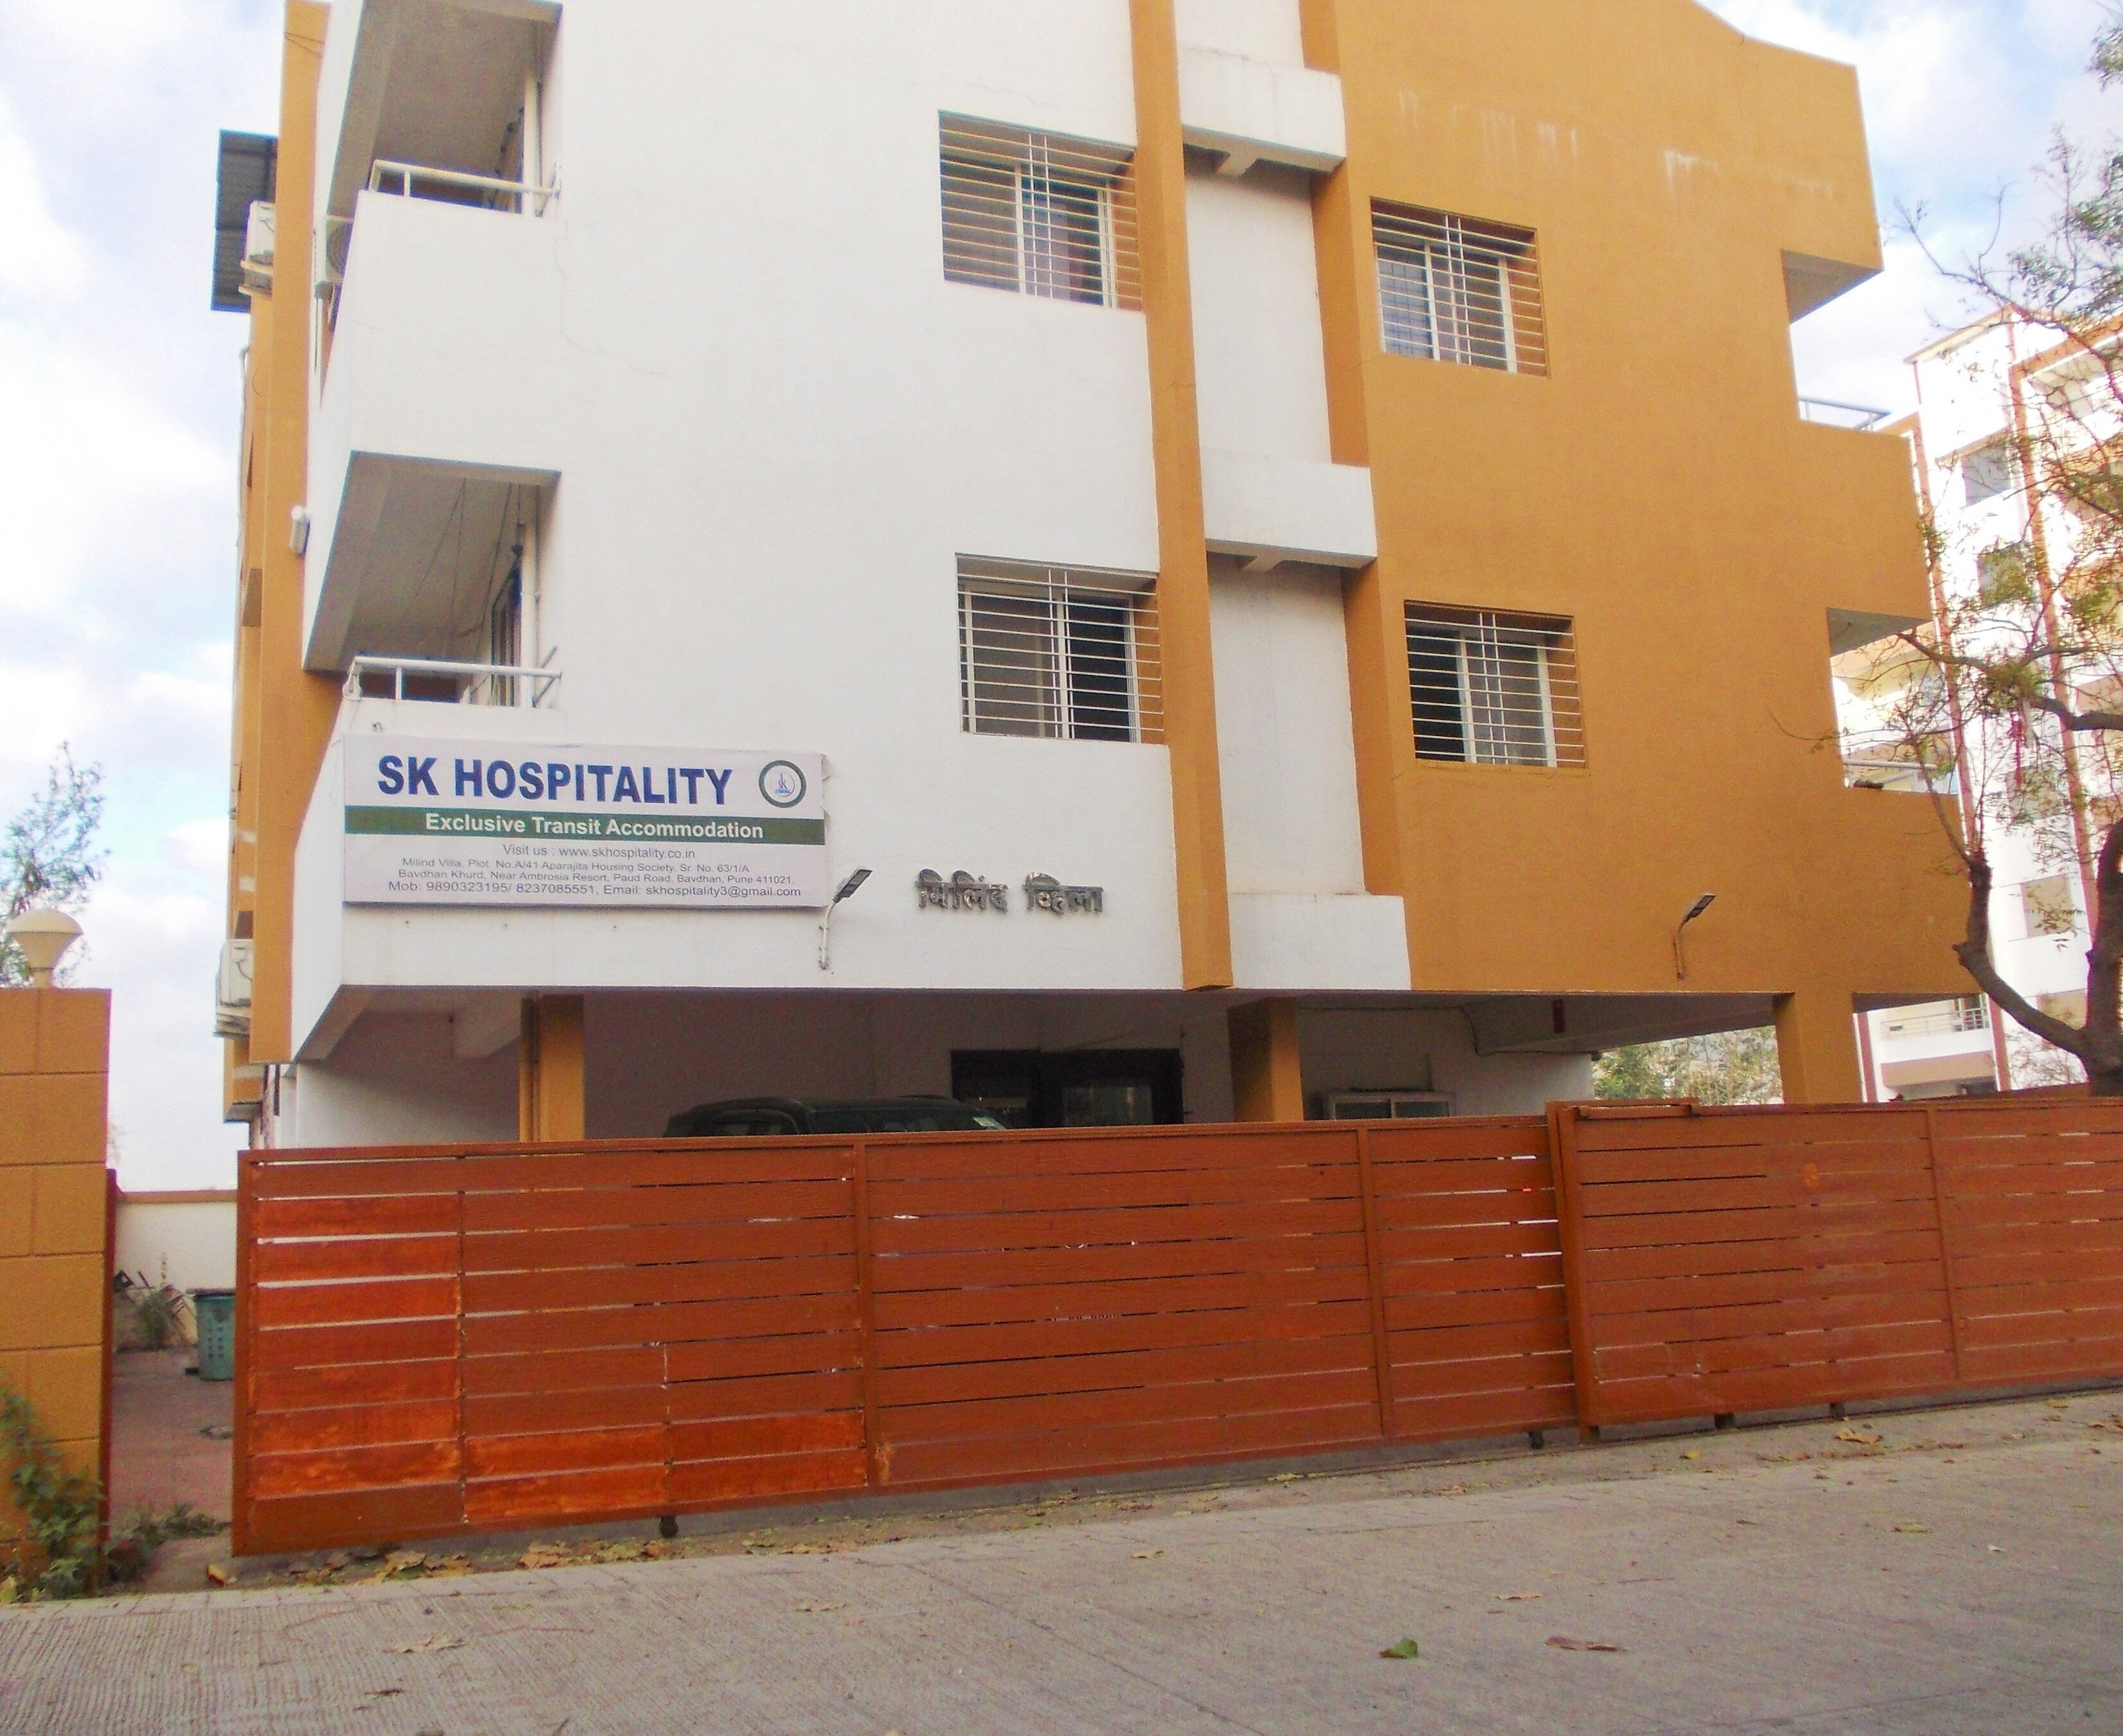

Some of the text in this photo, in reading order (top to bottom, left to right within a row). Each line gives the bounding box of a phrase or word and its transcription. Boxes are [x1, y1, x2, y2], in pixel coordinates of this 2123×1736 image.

[377, 755, 734, 806] SK HOSPITALITY
[425, 812, 764, 839] Exclusive Transit Accommodation
[503, 844, 529, 855] Visit
[533, 847, 547, 855] us
[558, 847, 696, 861] www.skhospitality.co.in
[402, 857, 434, 866] Milind
[542, 861, 588, 871] Aparajita
[592, 862, 633, 872] Housing
[717, 864, 750, 873] 63/1/A
[399, 869, 447, 878] Bavdhan
[490, 871, 515, 880] Near
[519, 872, 569, 881] Ambrosia
[614, 873, 640, 882] Paud
[677, 874, 725, 884] Bavdhan,
[727, 875, 753, 883] Pune
[388, 881, 421, 891] Mob:
[426, 881, 512, 893] 9890323195/
[603, 884, 641, 895] Email:
[646, 886, 801, 898] skhospitality3@gmail.com
